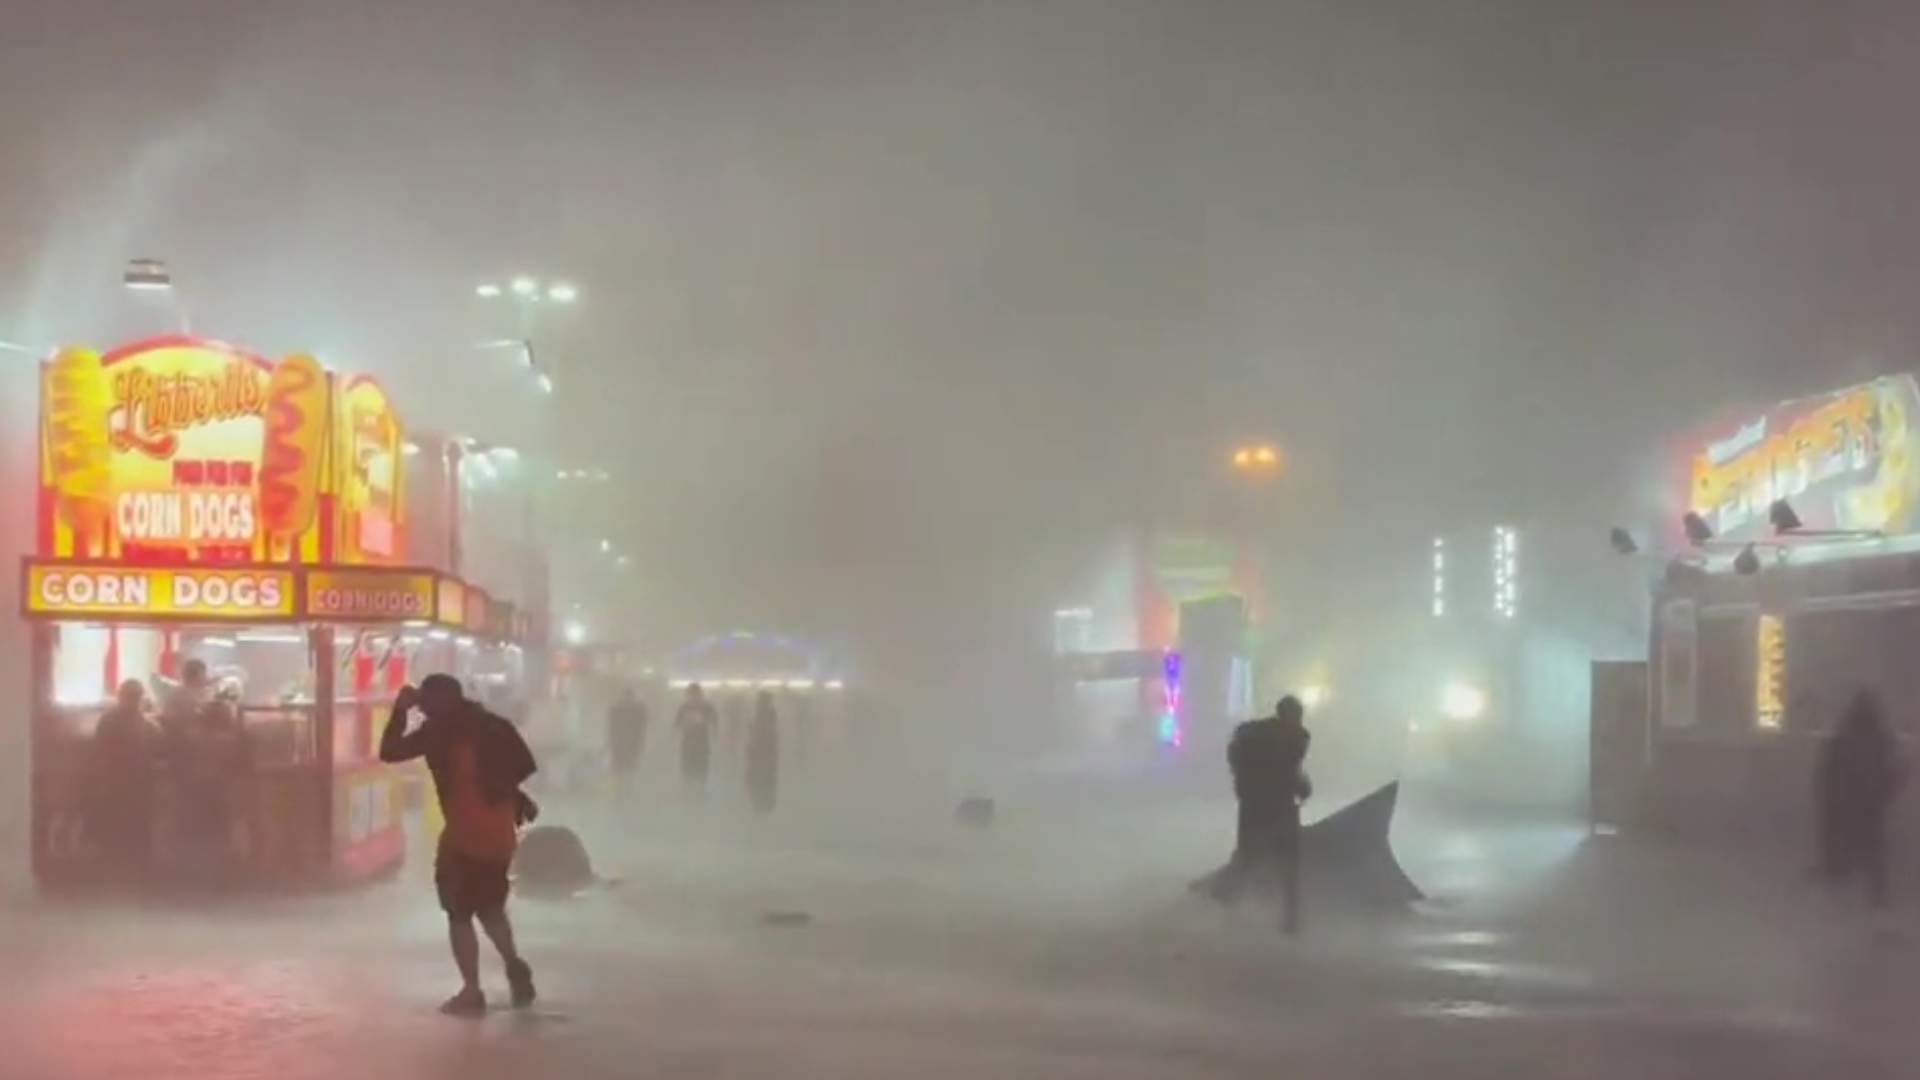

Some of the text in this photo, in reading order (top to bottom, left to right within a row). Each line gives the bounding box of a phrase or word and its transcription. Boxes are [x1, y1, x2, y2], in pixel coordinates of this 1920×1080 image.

[118, 492, 254, 539] CORN DOGS
[42, 574, 281, 607] CORN DOGS
